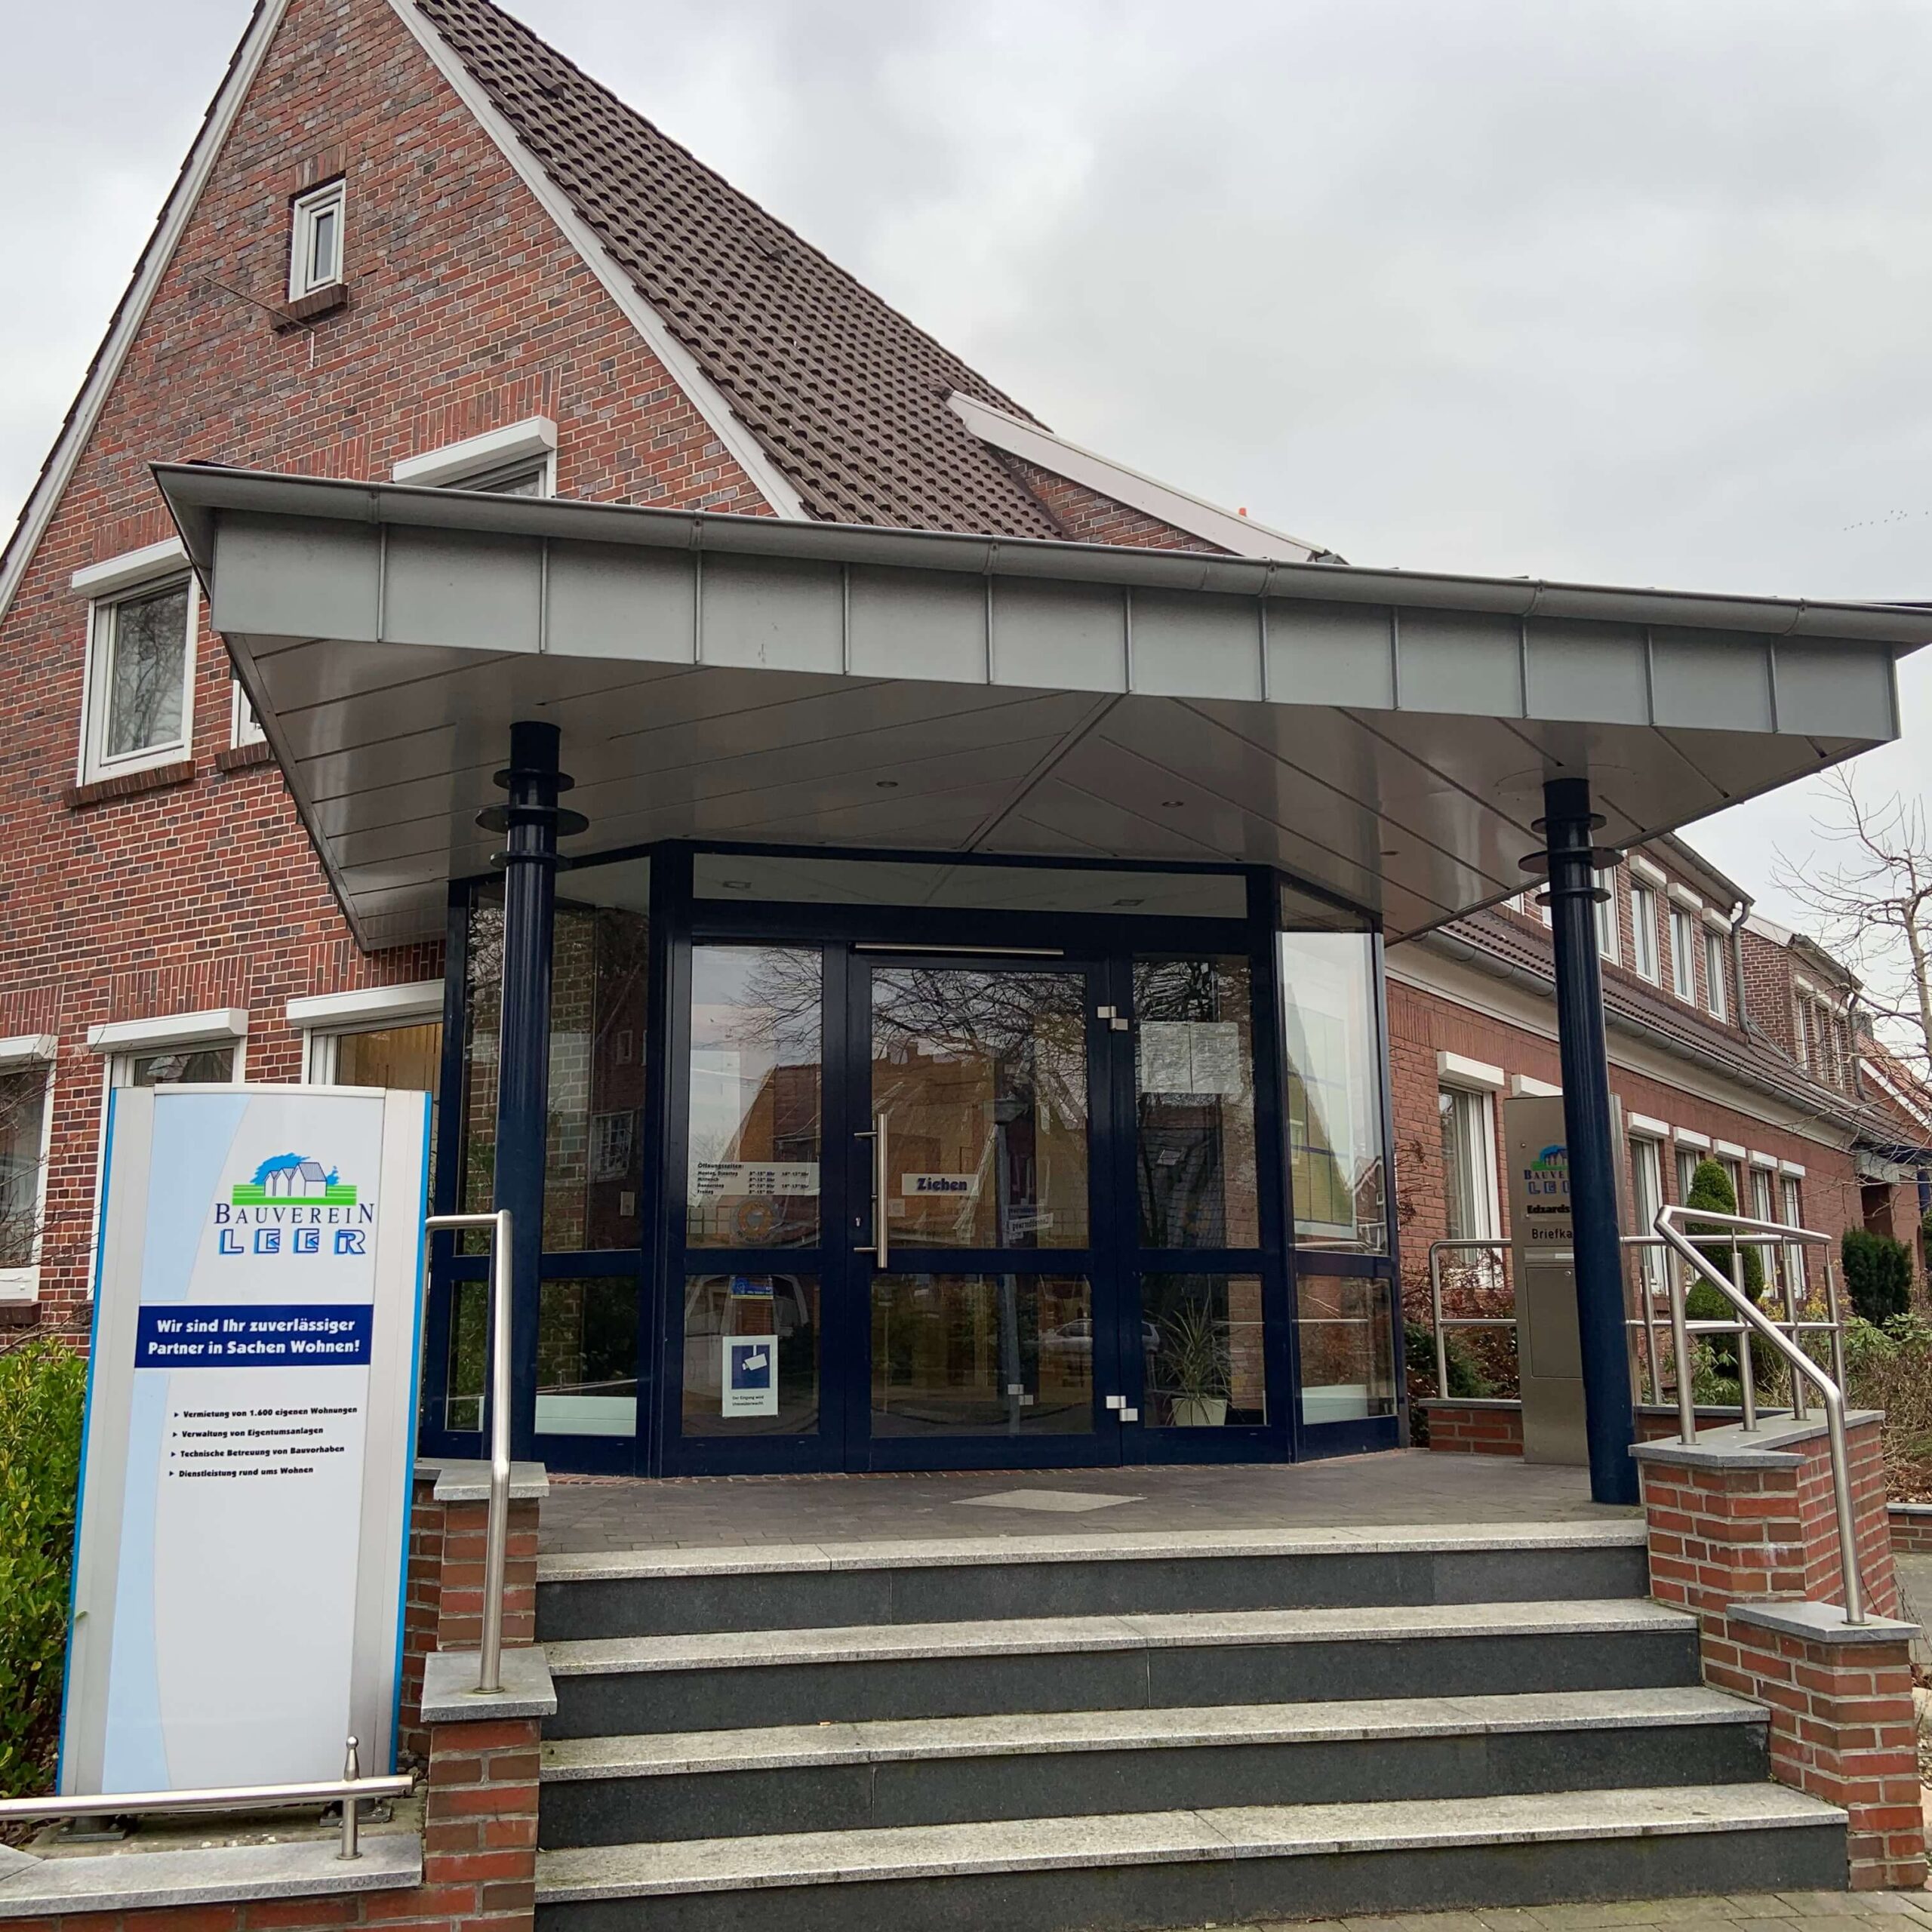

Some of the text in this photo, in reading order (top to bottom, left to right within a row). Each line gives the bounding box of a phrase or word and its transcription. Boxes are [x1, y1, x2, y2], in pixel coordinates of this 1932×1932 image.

[1524, 1170, 1564, 1180] BAUVE
[917, 1177, 968, 1191] Ziehen
[214, 1203, 375, 1224] BAUVEREIN
[1527, 1204, 1571, 1214] Edzards
[1532, 1229, 1573, 1239] Briefka
[219, 1228, 366, 1255] LEER
[157, 1318, 355, 1334] Wir sind Ihr zuverlässiger
[148, 1340, 360, 1355] Partner in Sachen Wohnen!
[182, 1430, 228, 1438] Verwaltung
[248, 1427, 324, 1437] Eigentumsanlagen
[290, 1445, 345, 1454] Bauvorhaben
[179, 1469, 237, 1478] Dienstleistung
